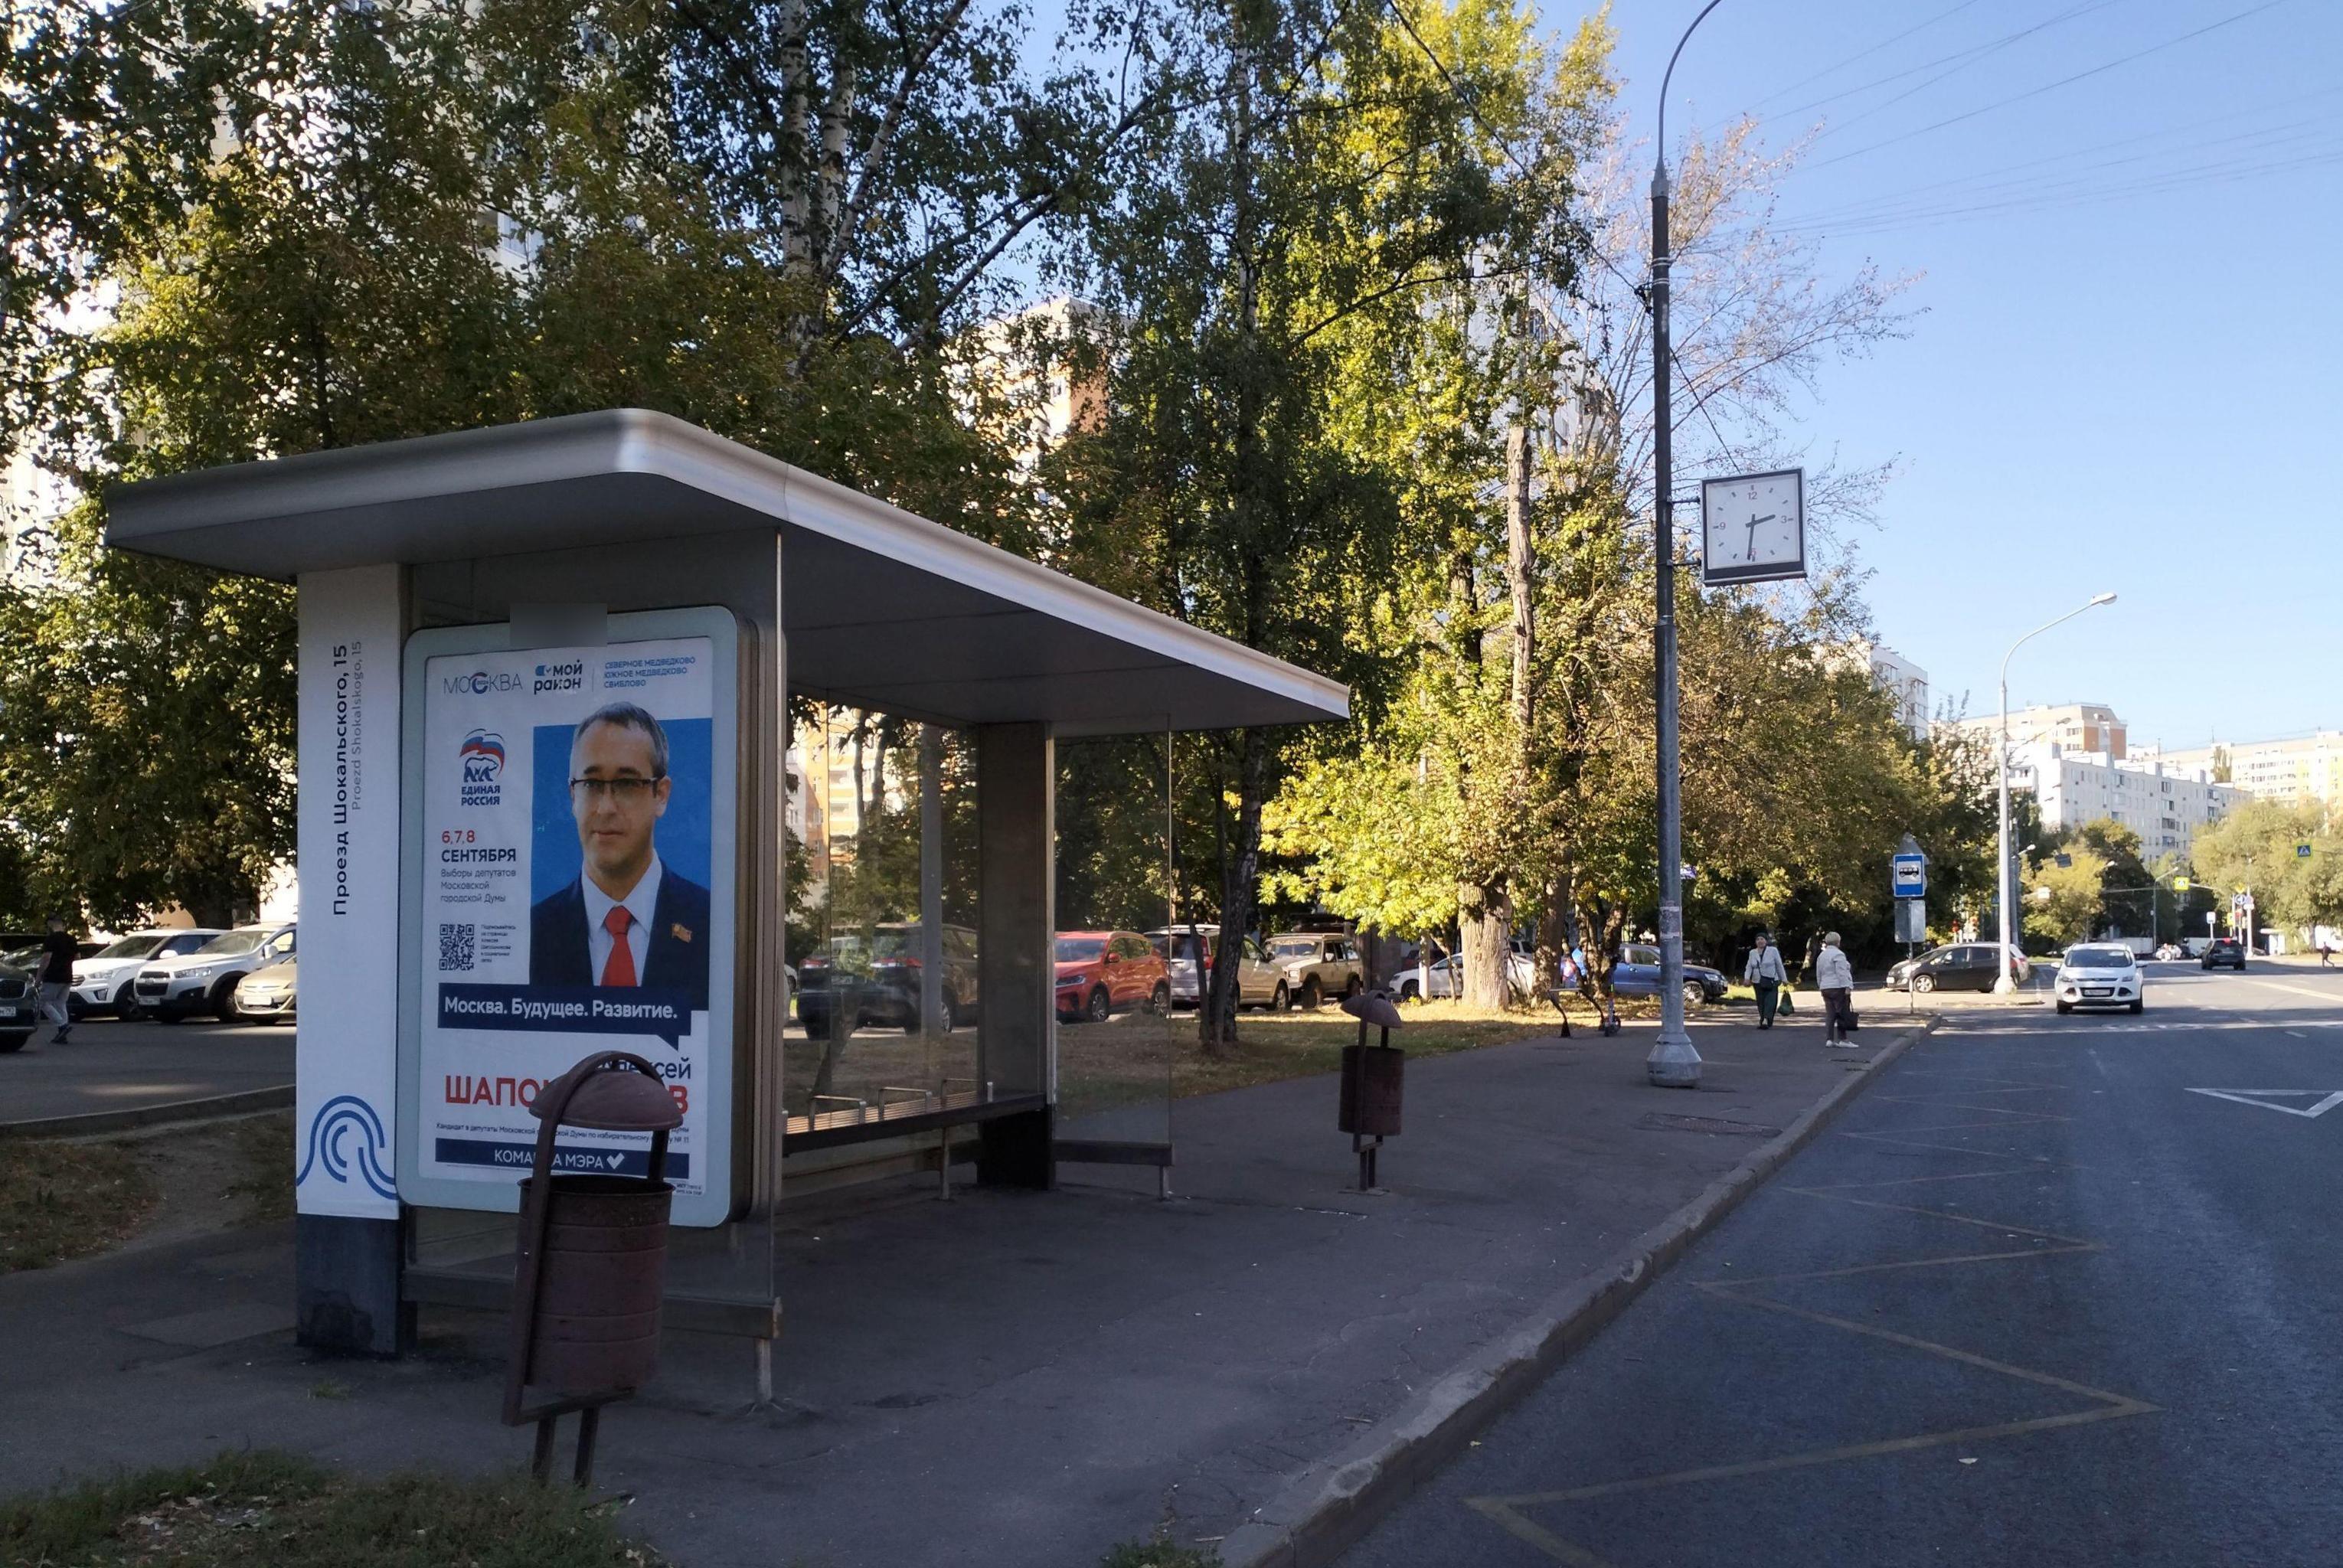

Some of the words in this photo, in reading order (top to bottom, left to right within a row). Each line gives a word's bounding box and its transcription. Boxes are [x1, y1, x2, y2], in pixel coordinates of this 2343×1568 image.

[1747, 492, 1757, 500] 12
[1719, 521, 1726, 530] 9
[1780, 515, 1787, 524] 3
[352, 641, 362, 656] 15
[334, 645, 348, 668] 15
[605, 660, 642, 669] СЕВЕРНОЕ
[645, 656, 695, 667] МЕДВЕДКОВО
[552, 658, 583, 676] мой
[604, 670, 633, 678] ЮЖНОЕ
[636, 667, 688, 677] МЕДВЕДКОВО
[443, 671, 524, 695] МОСКВА
[603, 679, 646, 688] СВИБЛОВО
[351, 659, 364, 756] Shokalskogo,
[334, 671, 349, 825] Шокальского,
[351, 760, 362, 810] Proezd
[461, 785, 501, 795] ЕДИНАЯ
[461, 795, 500, 806] РОССИЯ
[441, 848, 516, 862] СЕНТЯБРЯ
[333, 831, 350, 916] Проезд
[440, 868, 472, 878] Выборы
[475, 868, 516, 878] депутатов
[440, 880, 490, 890] Московской
[440, 892, 482, 903] городской
[484, 893, 506, 903] Думы
[444, 996, 507, 1014] Москва.
[511, 998, 589, 1019] Будущее.
[593, 1000, 678, 1019] Развитие.
[494, 1149, 562, 1167] КОМАА
[565, 1154, 604, 1169] МЭРА
